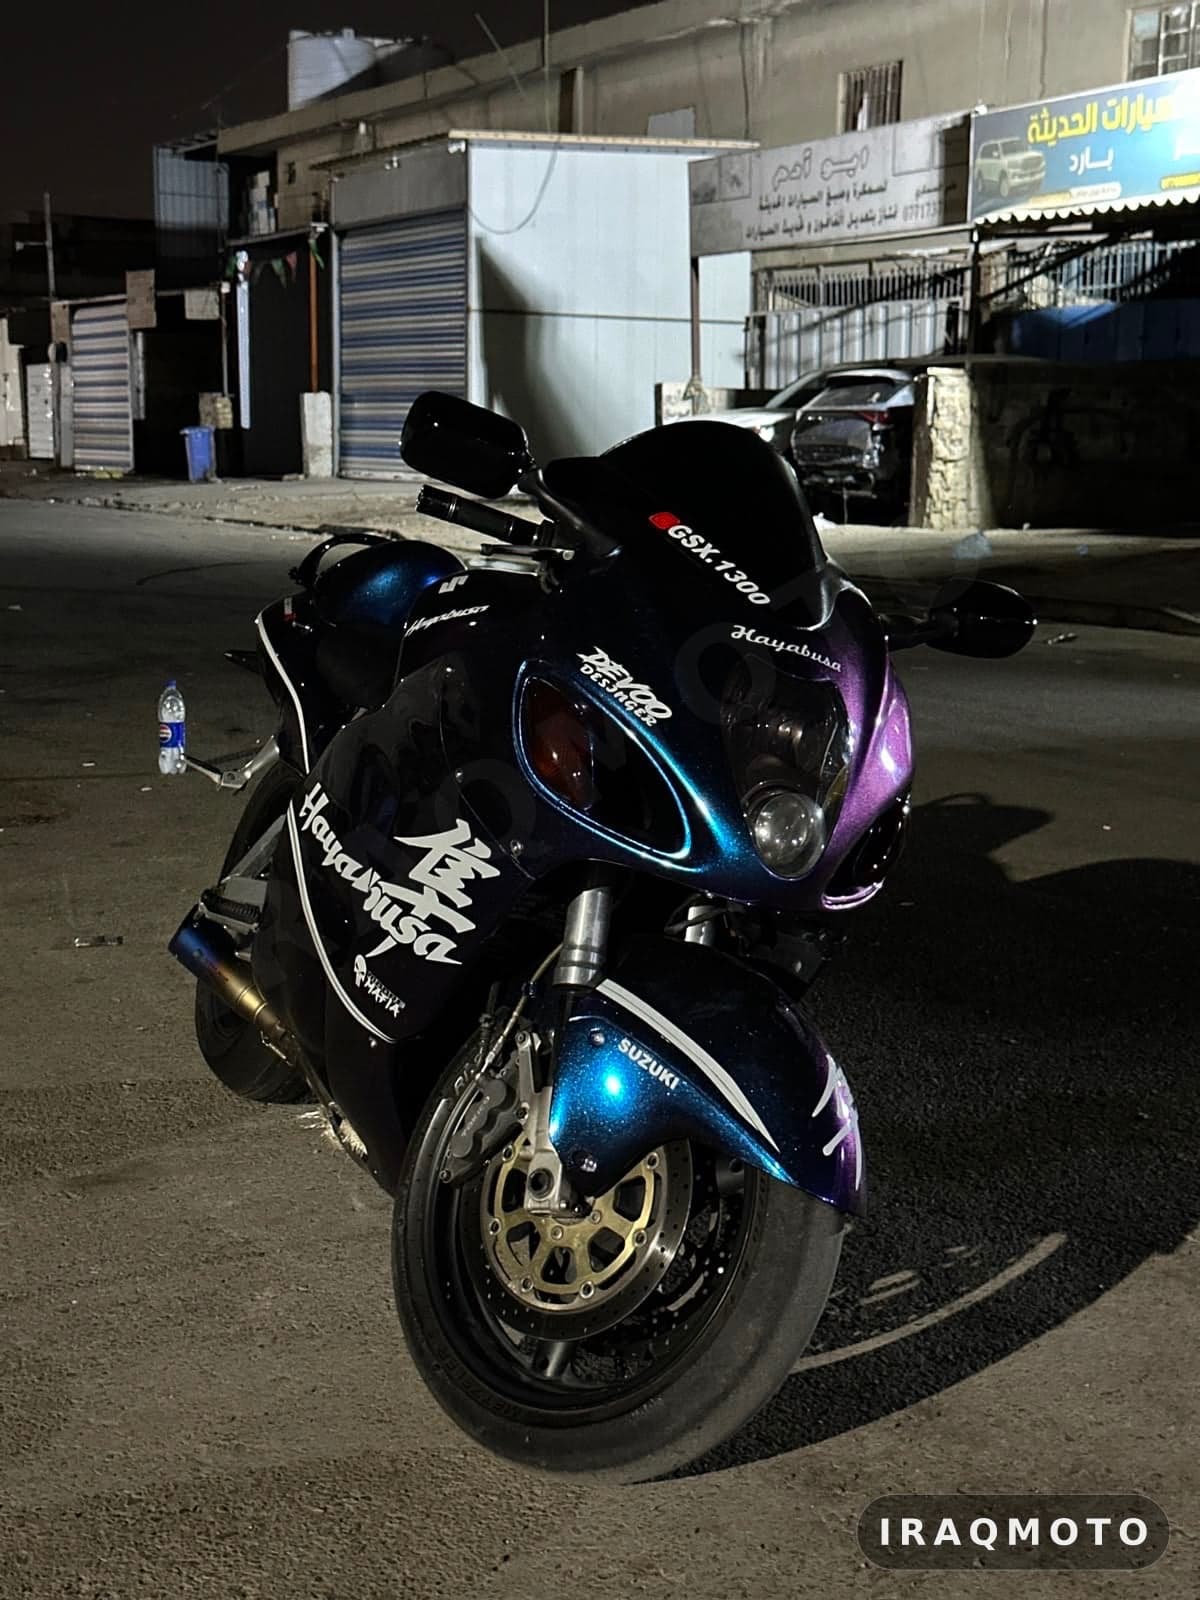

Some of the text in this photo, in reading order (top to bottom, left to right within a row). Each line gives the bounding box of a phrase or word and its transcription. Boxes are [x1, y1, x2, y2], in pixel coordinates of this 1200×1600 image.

[1026, 101, 1098, 147] الحديثة
[1069, 146, 1114, 175] بارد
[667, 522, 771, 607] GSX.1300
[729, 624, 843, 673] Hayabusa
[299, 782, 463, 965] Hayabusa
[364, 976, 401, 1018] MAFIA
[617, 1038, 680, 1091] SUZUKI
